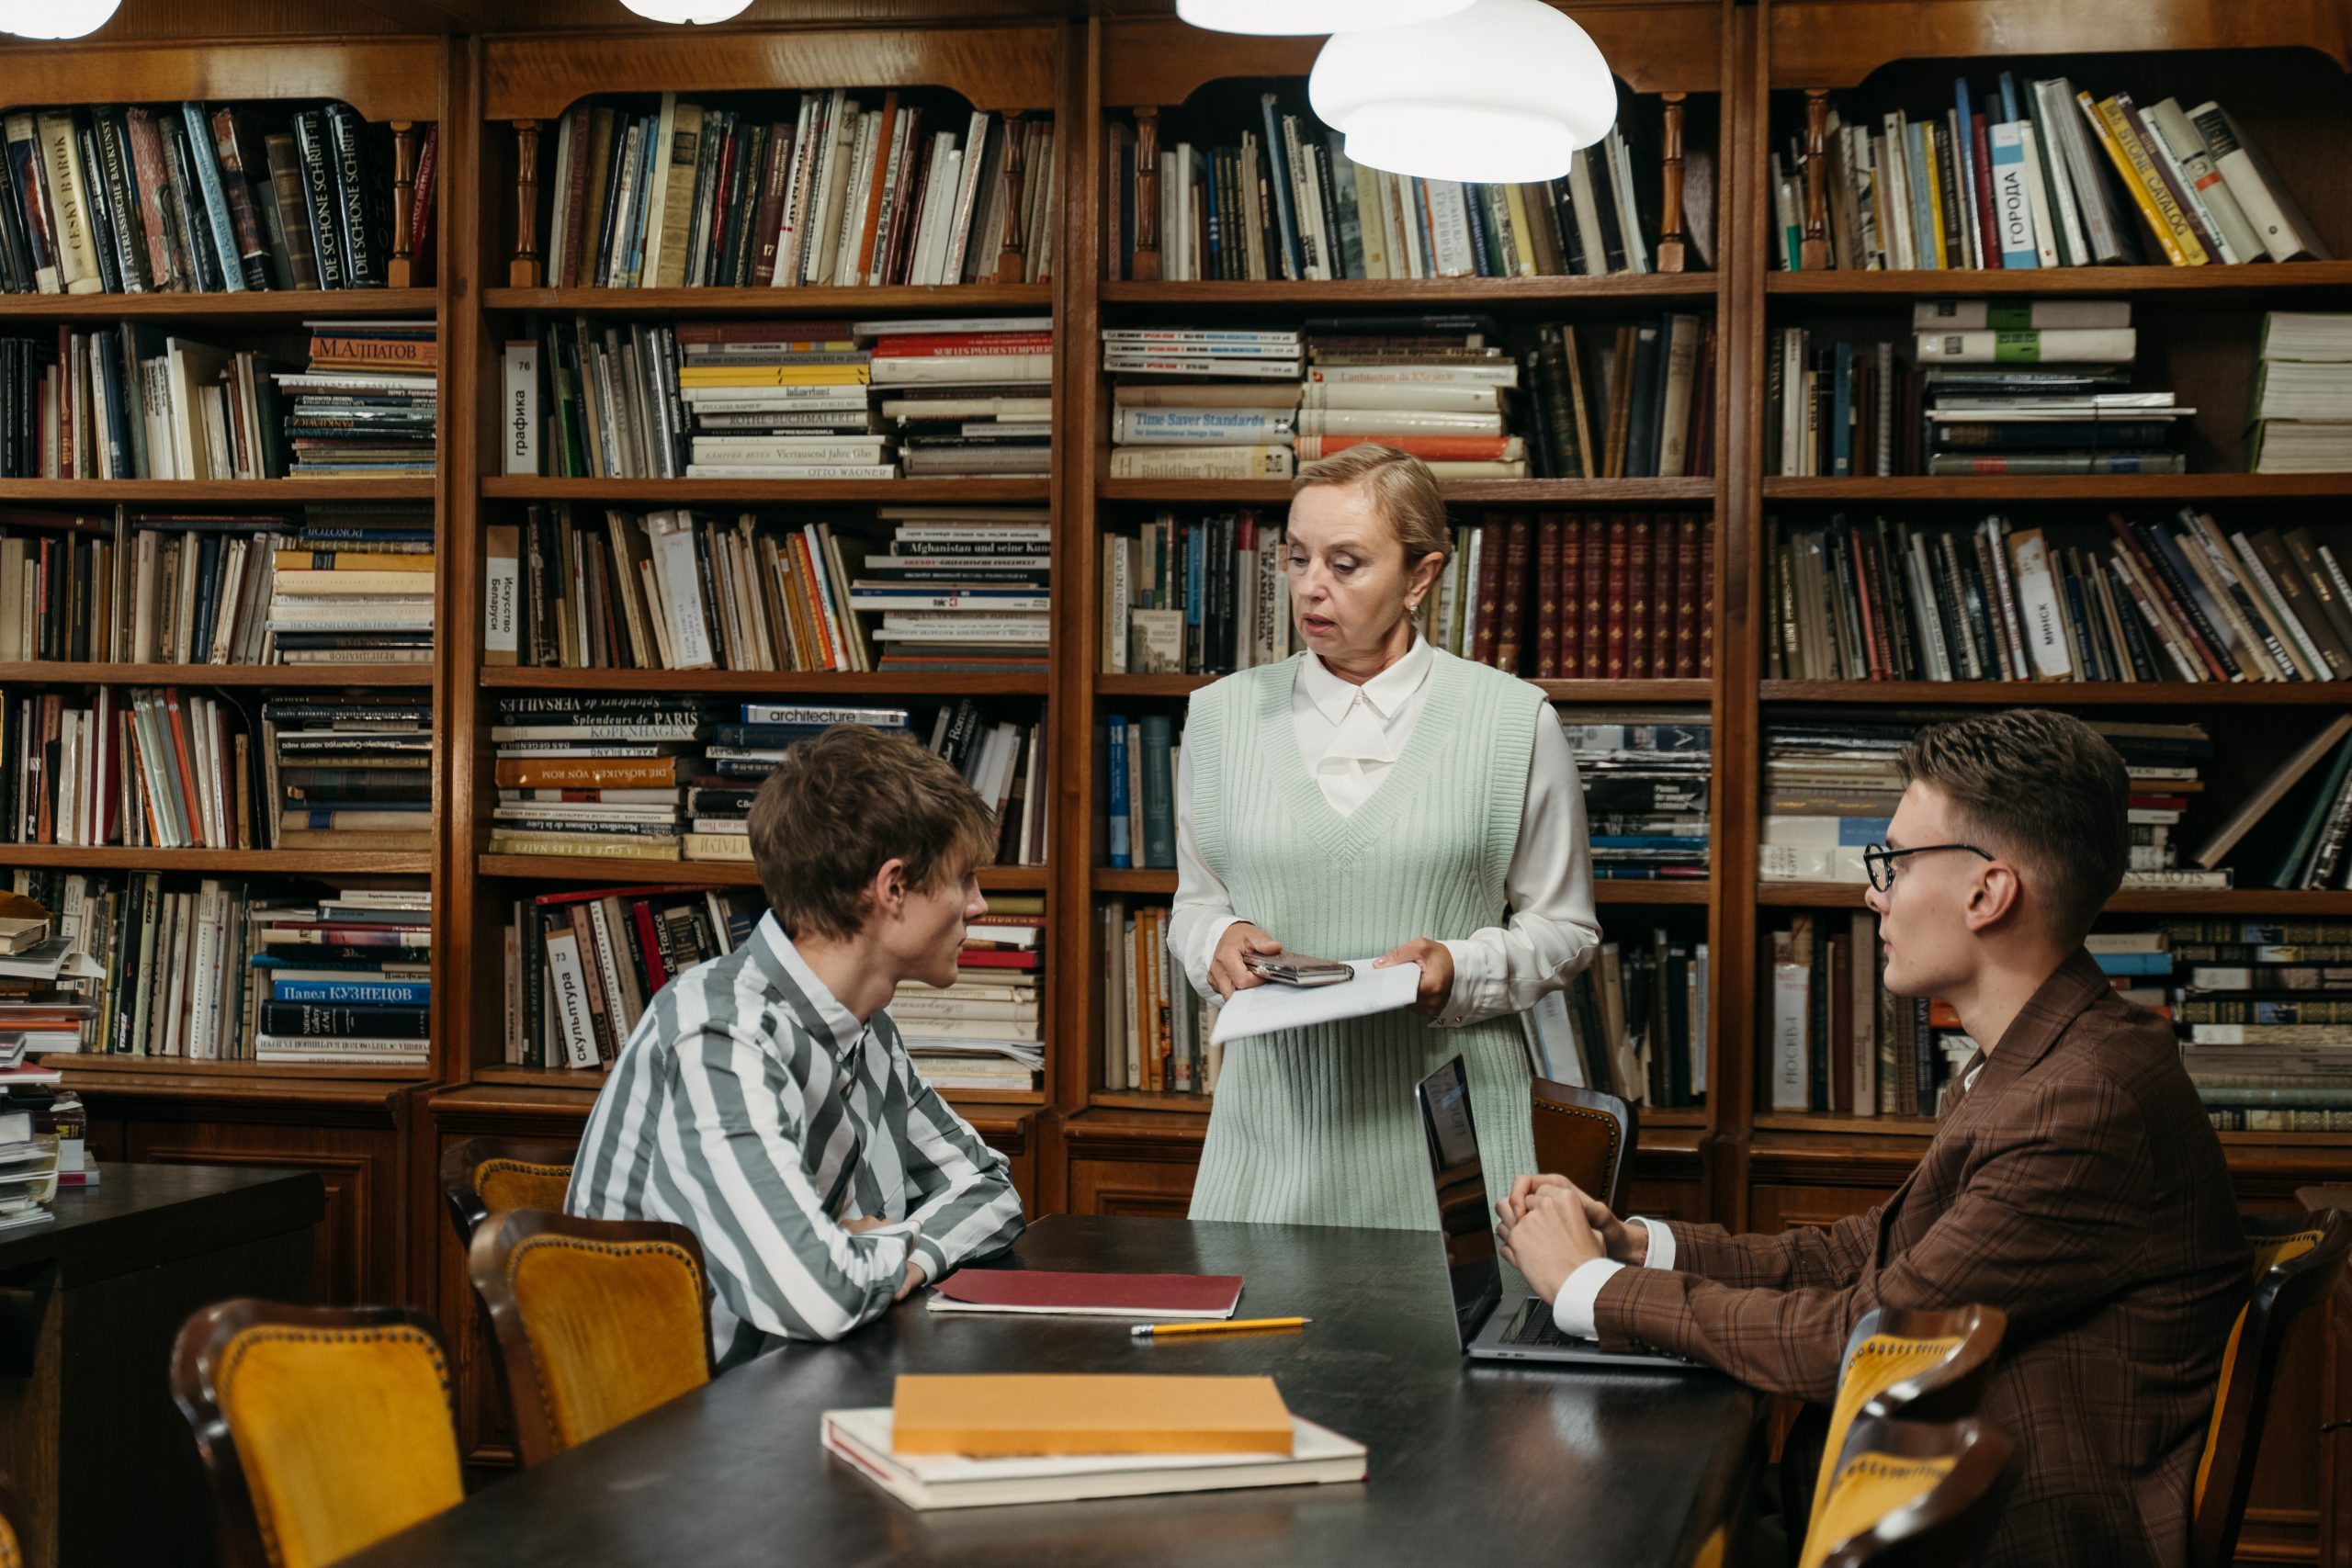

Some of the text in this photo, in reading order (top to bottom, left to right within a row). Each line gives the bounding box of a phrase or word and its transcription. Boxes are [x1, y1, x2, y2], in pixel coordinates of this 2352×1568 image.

[52, 135, 74, 193] BAROK
[2119, 129, 2191, 237] STONE CATALOG
[101, 118, 134, 267] ALTRUSSISCHE BAUKUNST
[2003, 171, 2026, 245] ГОРОДА
[763, 243, 775, 257] 17
[324, 255, 339, 281] DIE
[356, 250, 368, 275] DIE
[518, 361, 531, 371] 76
[293, 418, 354, 427] PANKIEWICZ
[513, 389, 529, 456] графика
[1203, 413, 1266, 427] Standards
[776, 447, 873, 460] Viertausend Jahre Glas
[808, 468, 888, 477] OTTO WAGNER
[1141, 463, 1247, 479] Building Types
[910, 543, 1023, 555] Afghanistan und seine
[490, 578, 501, 631] Беларуси
[503, 576, 514, 634] Искусство
[2038, 603, 2055, 646] МИНСК
[499, 696, 660, 712] Splendeurs de VERSAILLES
[572, 711, 698, 727] Splendeurs de PARIS
[769, 707, 856, 724] architecture
[590, 726, 688, 737] KOPENHAGEN
[542, 769, 667, 779] DIE MOSAIKEN VON ROM
[700, 837, 744, 853] СТАТУИ
[1786, 846, 1797, 879] EGYPT
[2122, 872, 2205, 884] SLOVENS
[652, 914, 675, 972] de France
[554, 953, 567, 963] 73
[284, 986, 413, 1002] Павел КУЗНЕЦОВ
[560, 971, 587, 1062] скульптура
[1785, 1016, 1799, 1085] МОСКВА
